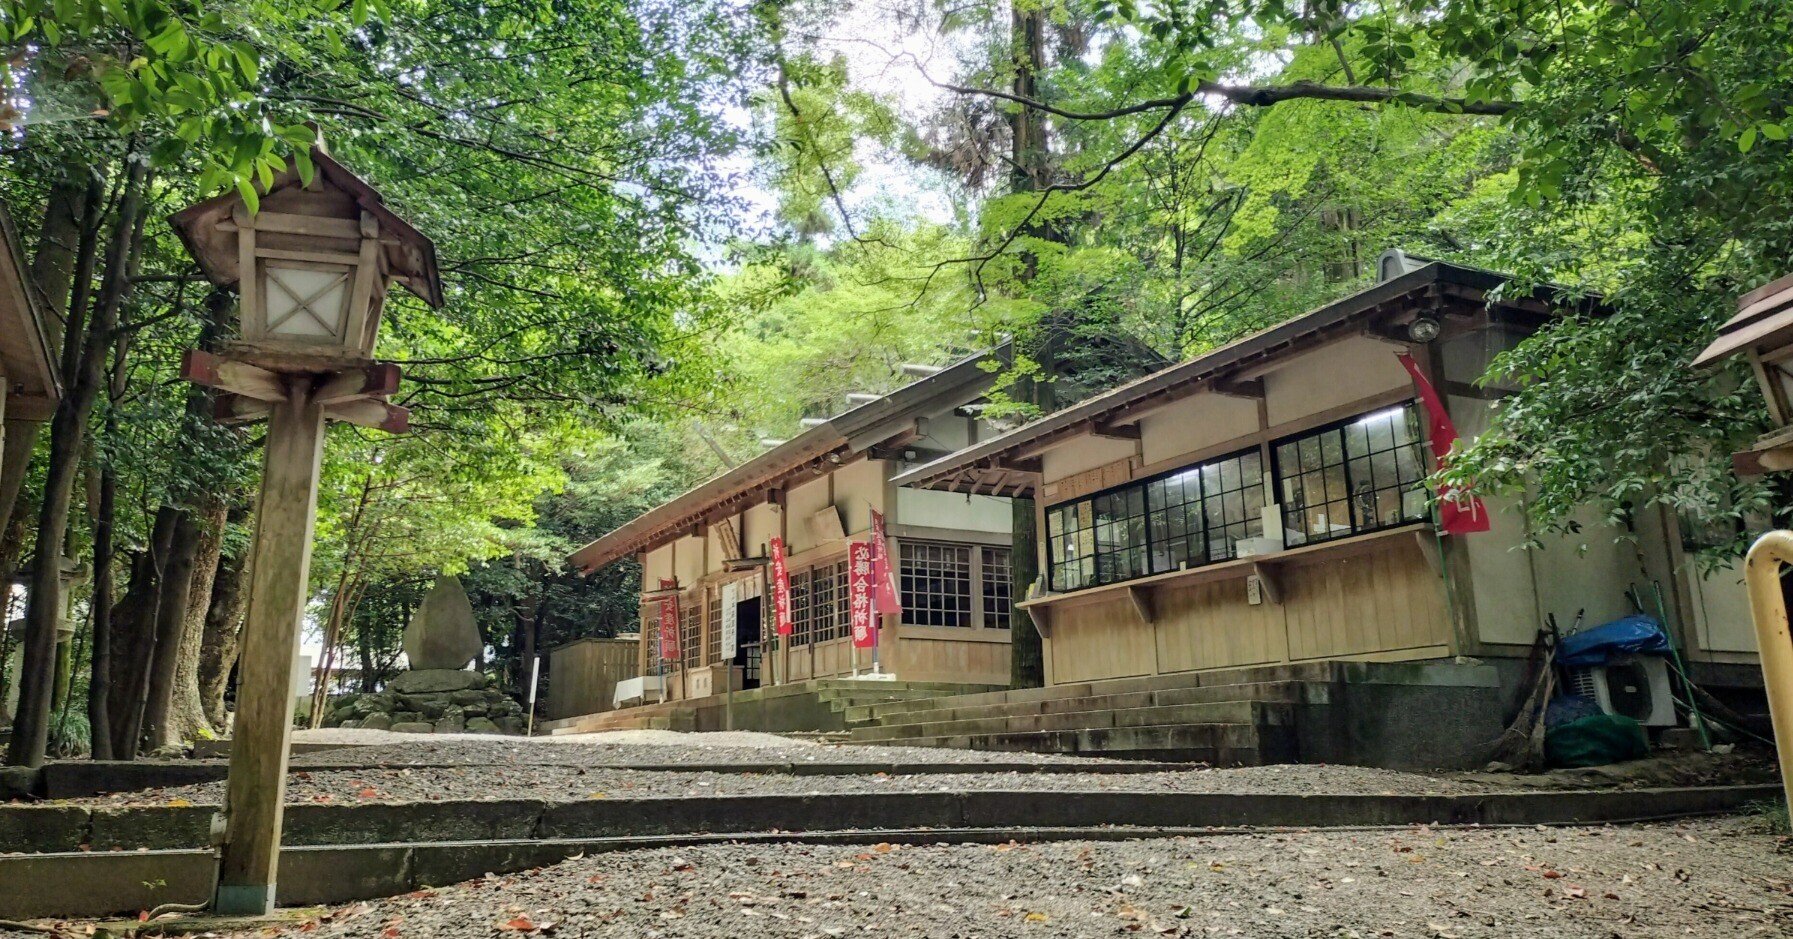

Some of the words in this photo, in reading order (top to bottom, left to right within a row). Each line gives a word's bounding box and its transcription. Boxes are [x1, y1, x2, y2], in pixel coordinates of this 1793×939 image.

[853, 546, 870, 641] 必勝合格祈願
